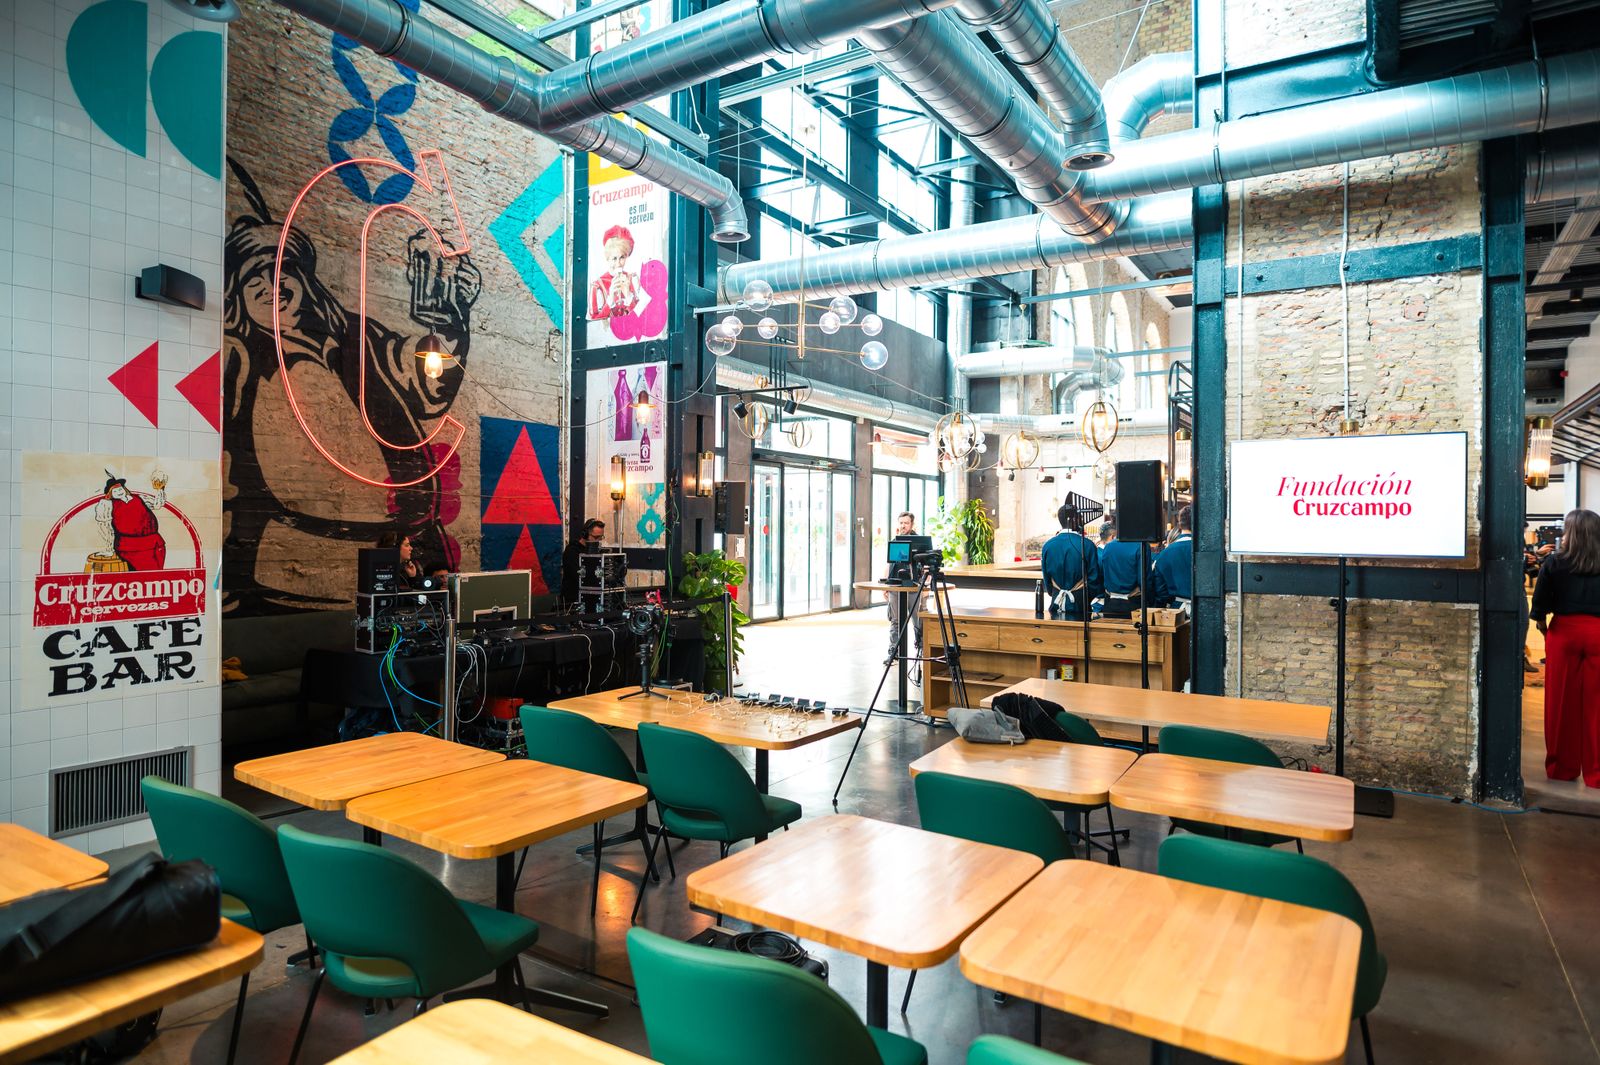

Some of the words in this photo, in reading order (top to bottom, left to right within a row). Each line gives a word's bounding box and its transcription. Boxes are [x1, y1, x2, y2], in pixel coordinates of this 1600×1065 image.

[592, 183, 653, 206] Cruzcampo
[629, 205, 637, 215] es
[638, 202, 648, 213] mi
[1276, 472, 1413, 497] Fundación
[1293, 498, 1413, 520] Cruzcampo
[39, 577, 204, 606] Cruzcampo
[80, 600, 169, 616] cervezas
[48, 650, 196, 697] BAR
